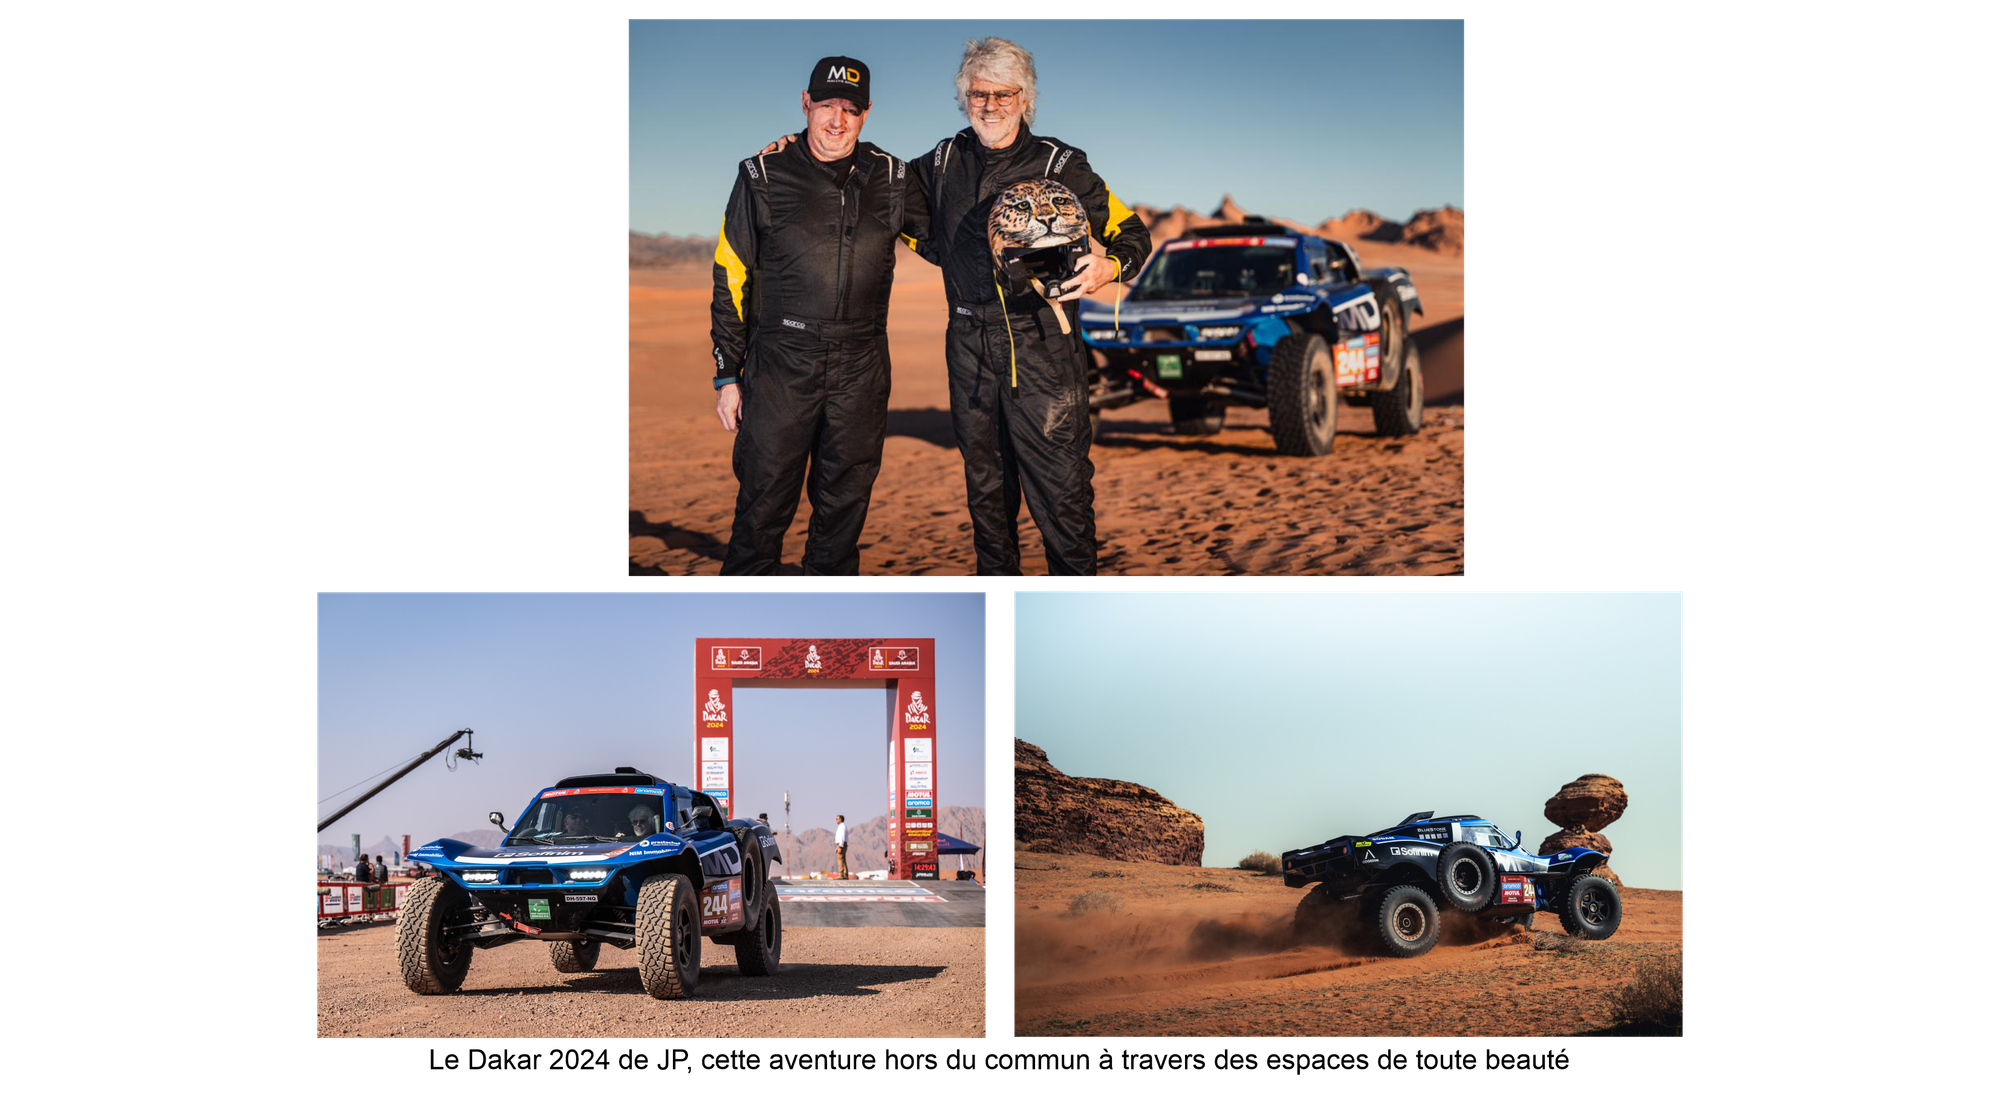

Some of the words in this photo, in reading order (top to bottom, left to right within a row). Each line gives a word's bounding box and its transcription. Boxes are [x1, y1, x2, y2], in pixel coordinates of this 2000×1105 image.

[828, 65, 860, 83] MD
[1053, 149, 1074, 174] sparco
[782, 318, 806, 330] sparco
[804, 660, 822, 669] DAKAR
[702, 710, 728, 722] DAKAR
[905, 712, 931, 724] DAKAR
[543, 790, 567, 798] MOTUL
[514, 849, 584, 858] Sofinim
[1401, 847, 1434, 857] Sofinim
[701, 843, 742, 876] MD
[914, 863, 937, 871] 14:29:43
[703, 894, 728, 917] 244
